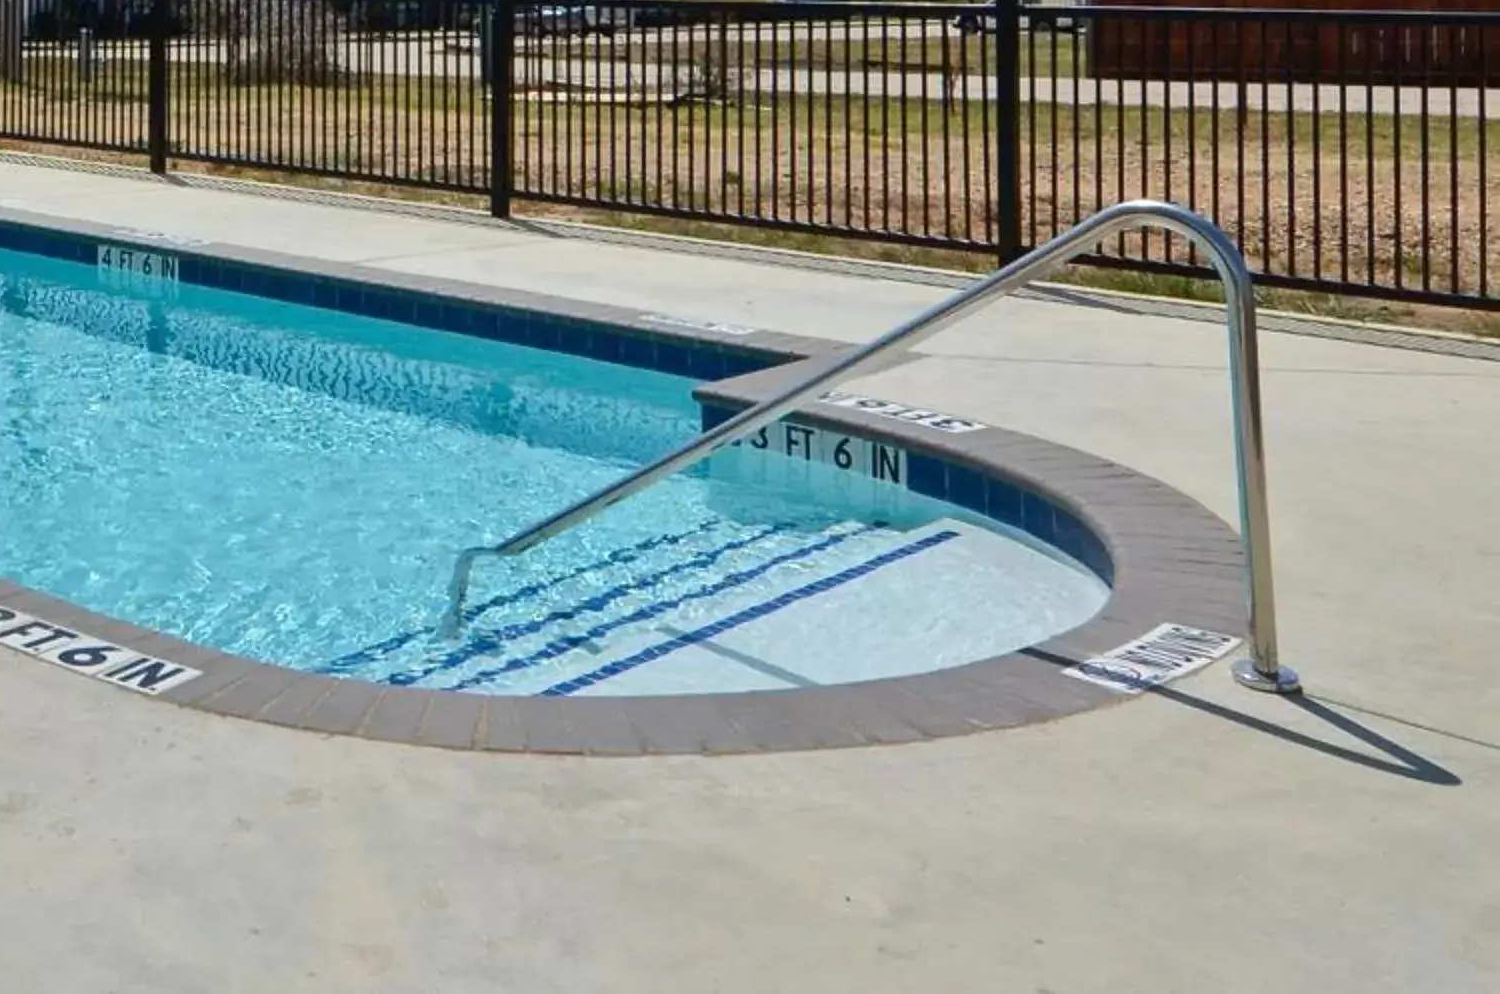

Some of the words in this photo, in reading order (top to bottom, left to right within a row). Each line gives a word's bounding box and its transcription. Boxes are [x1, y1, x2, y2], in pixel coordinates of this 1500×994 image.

[101, 248, 111, 270] 4
[119, 249, 133, 271] FT
[143, 254, 153, 276] 6
[161, 256, 176, 279] IN
[785, 425, 816, 461] FT
[833, 437, 852, 470] 6
[870, 441, 900, 485] IN
[57, 644, 123, 667] 6
